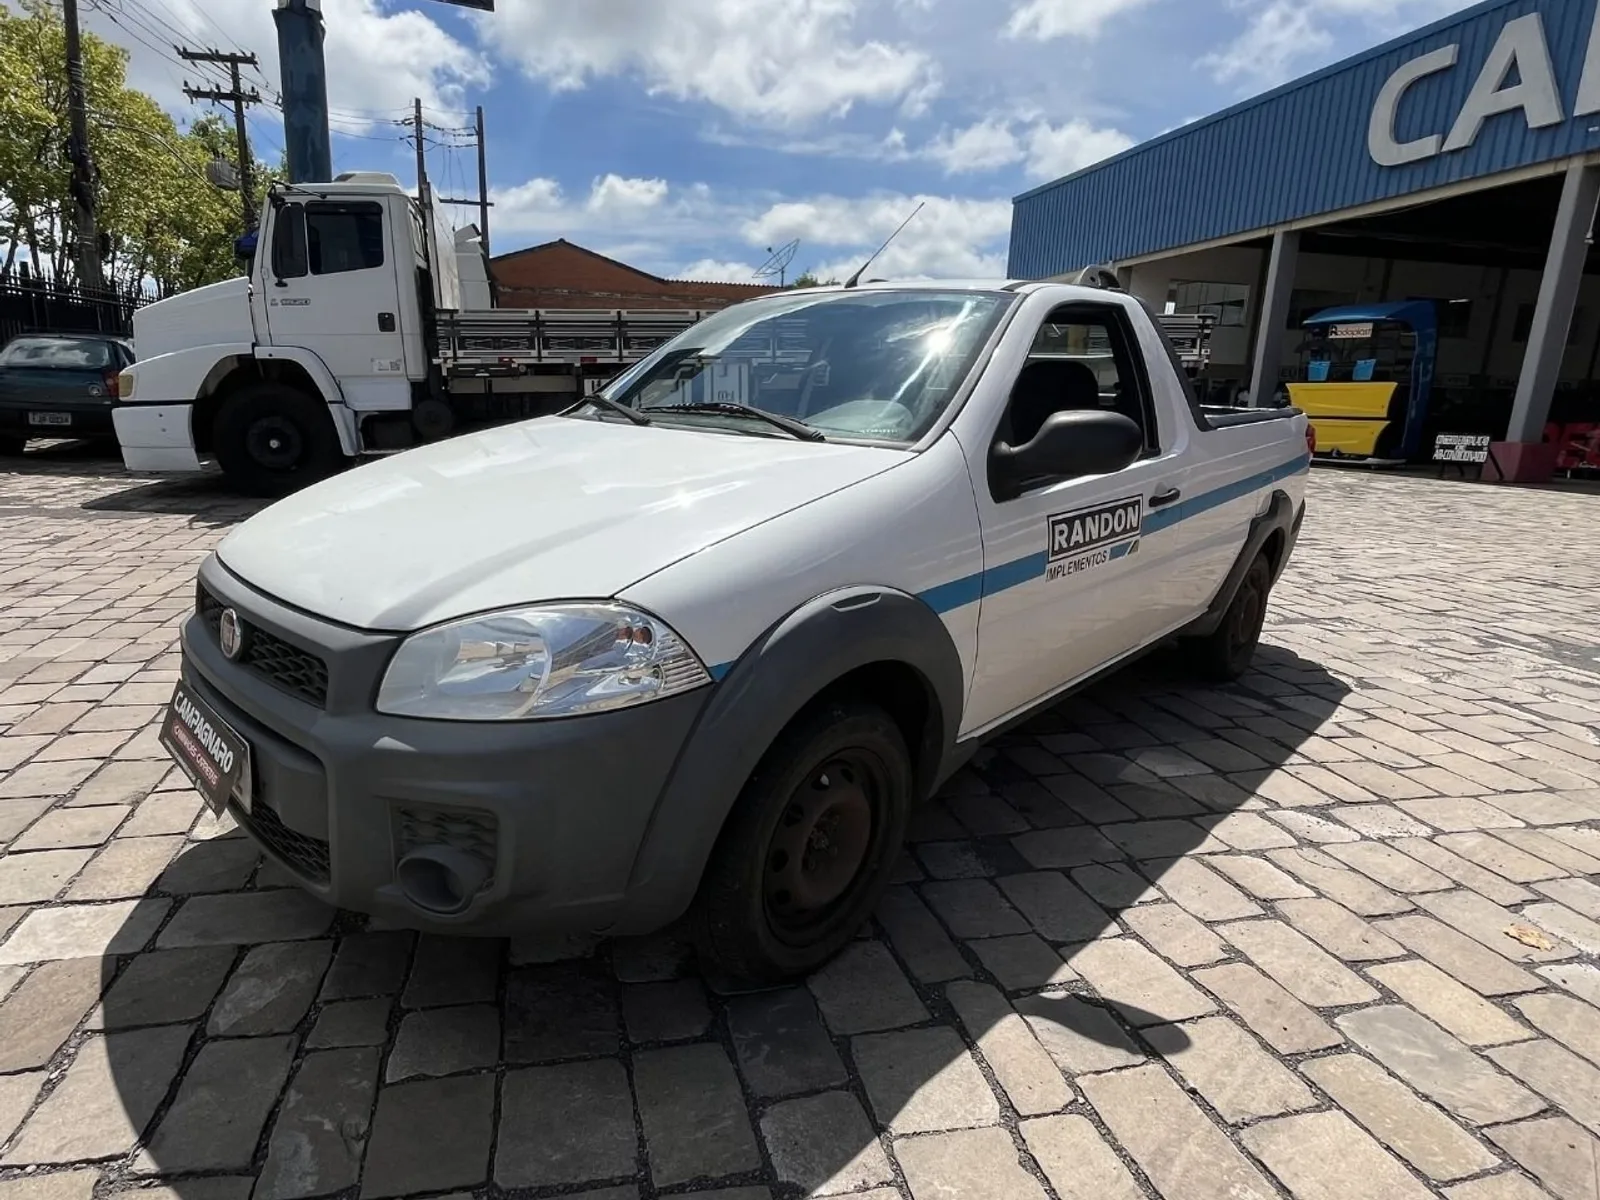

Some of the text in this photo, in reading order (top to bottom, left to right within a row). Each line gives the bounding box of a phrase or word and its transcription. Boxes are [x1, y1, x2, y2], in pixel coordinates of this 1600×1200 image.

[1368, 0, 1600, 166] CA
[1053, 505, 1139, 551] RANDON
[1045, 550, 1108, 582] IMPLEMENTOS
[173, 690, 234, 774] CAMPAGNARO
